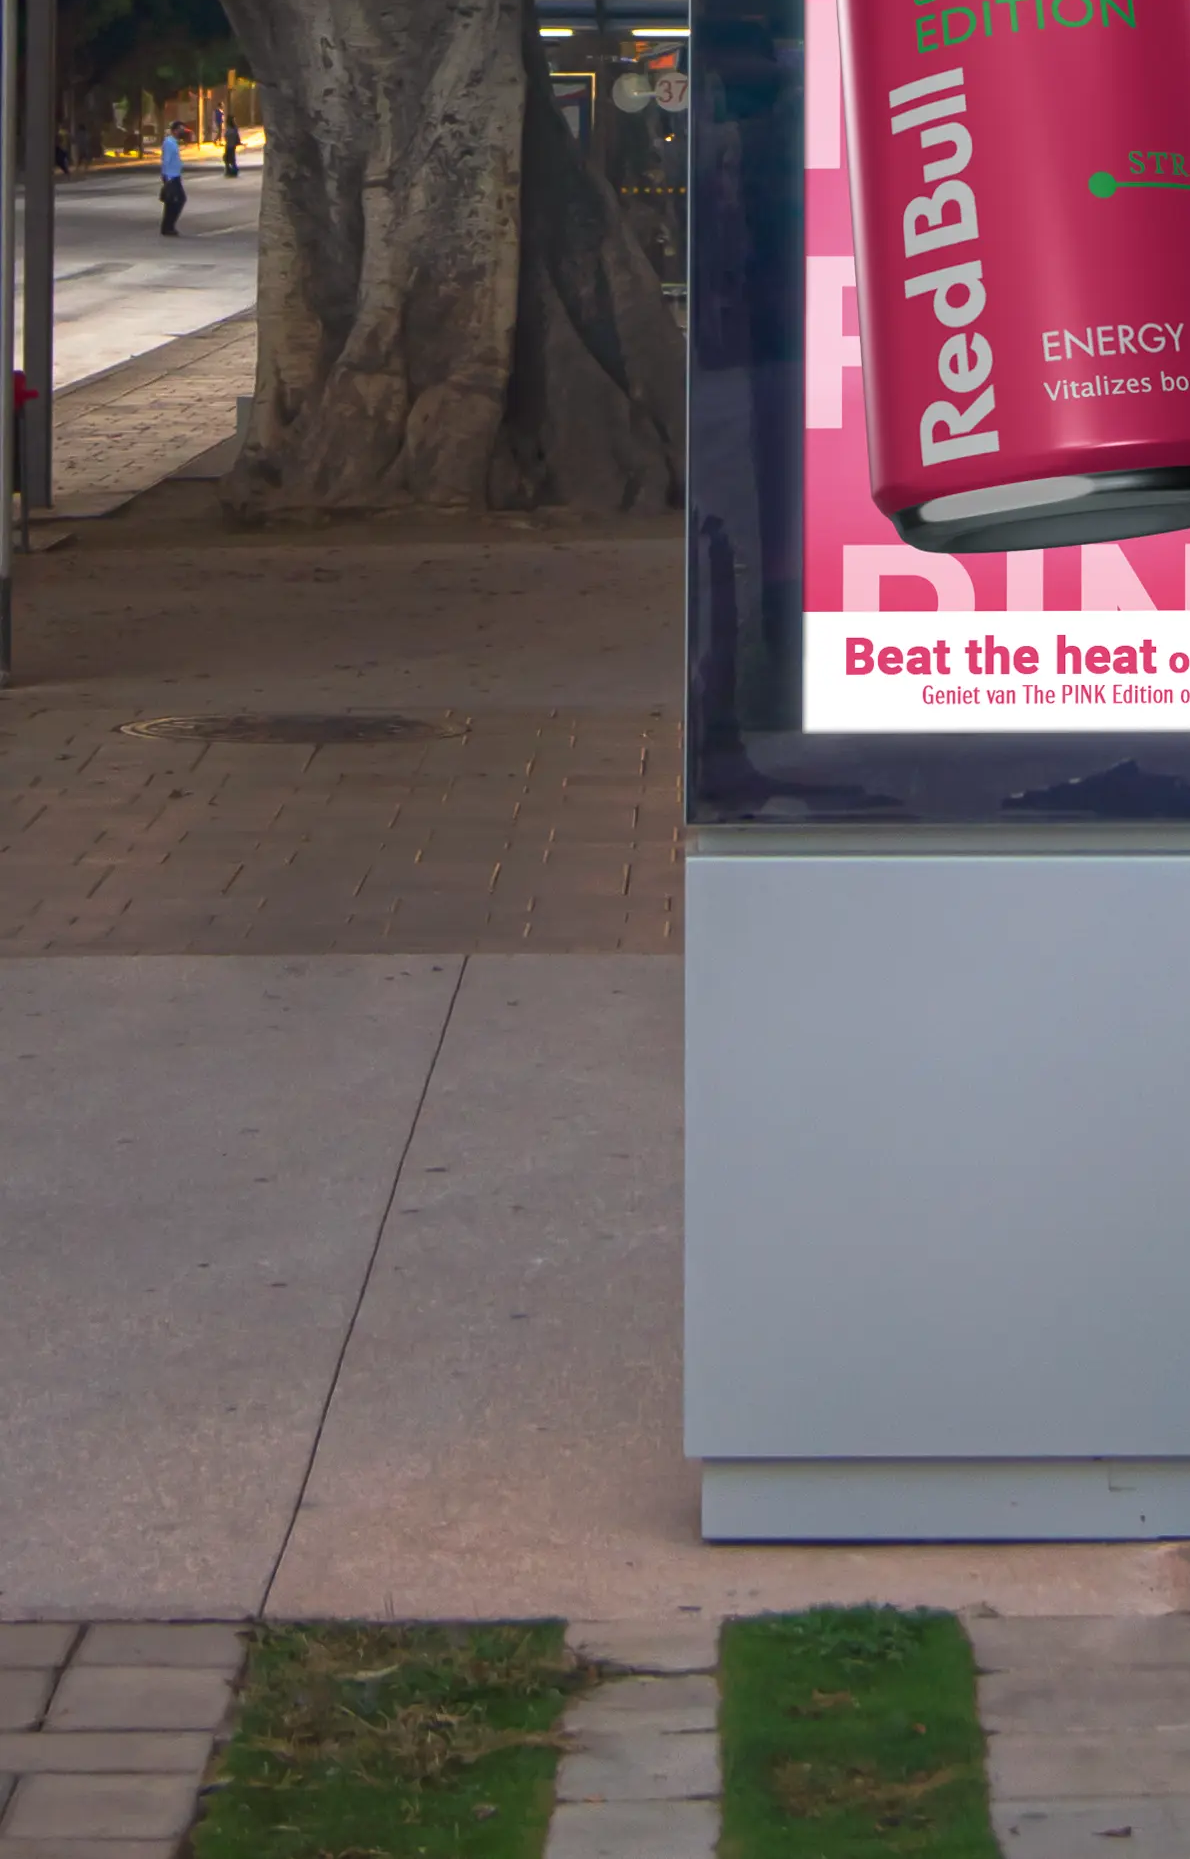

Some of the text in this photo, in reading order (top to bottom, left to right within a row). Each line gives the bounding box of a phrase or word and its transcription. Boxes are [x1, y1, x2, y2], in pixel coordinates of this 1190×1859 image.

[888, 66, 1001, 467] Red Bull
[1042, 323, 1185, 362] ENERGY
[1043, 375, 1152, 401] Vitalizes
[845, 637, 951, 675] Beat
[965, 634, 1040, 675] the
[1056, 634, 1158, 674] heat
[922, 684, 981, 705] Geniet
[986, 689, 1016, 705] van
[1022, 684, 1056, 704] The
[1062, 684, 1107, 704] PINK
[1113, 684, 1174, 704] Edition
